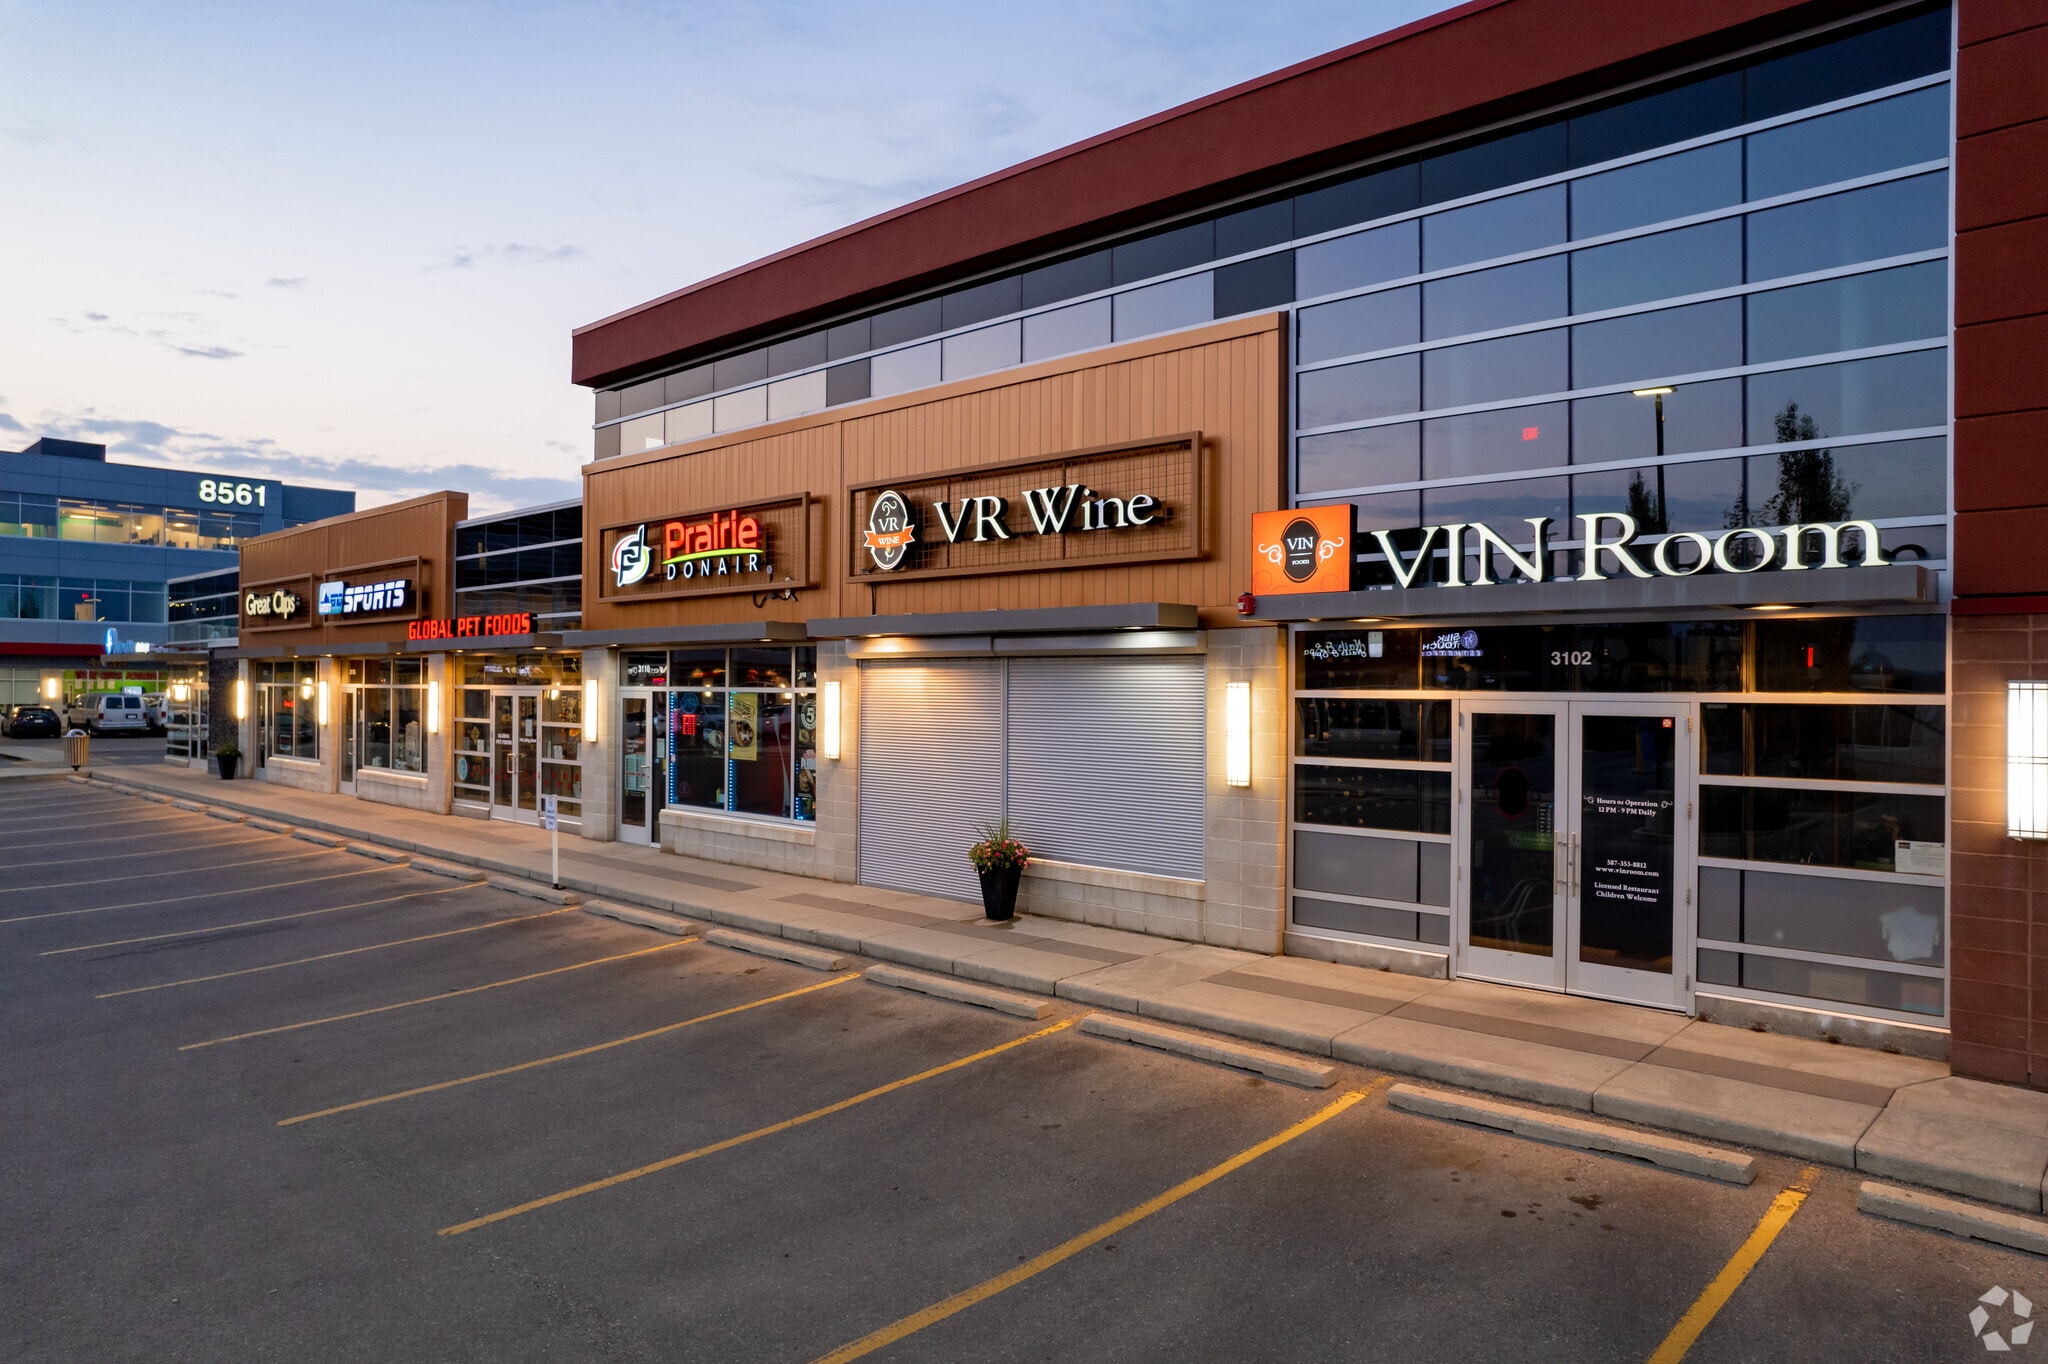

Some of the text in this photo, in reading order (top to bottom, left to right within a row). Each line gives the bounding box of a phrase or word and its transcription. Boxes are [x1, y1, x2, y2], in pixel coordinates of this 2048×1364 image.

[199, 480, 266, 507] 8561
[933, 484, 1155, 544] VR Wine
[878, 517, 900, 532] VR
[665, 510, 759, 559] Prairie
[878, 536, 900, 546] WINE
[1286, 536, 1314, 550] VIN
[1371, 512, 1890, 589] VIN Room
[667, 554, 759, 581] DONAIR
[343, 580, 406, 613] SPORTS
[245, 590, 296, 620] Great Clips
[408, 612, 531, 640] GLOBAL PET FOODS
[1550, 651, 1592, 666] 3102
[638, 664, 651, 674] 3110
[1596, 797, 1616, 805] Hours
[1625, 799, 1658, 808] Operation
[1638, 809, 1656, 817] Daily
[1595, 866, 1659, 877] www.vinroom.com
[1606, 859, 1647, 869] 587-353-8812
[1594, 881, 1659, 894] Licensed Restaurant
[1595, 890, 1657, 902] Children Welcome
